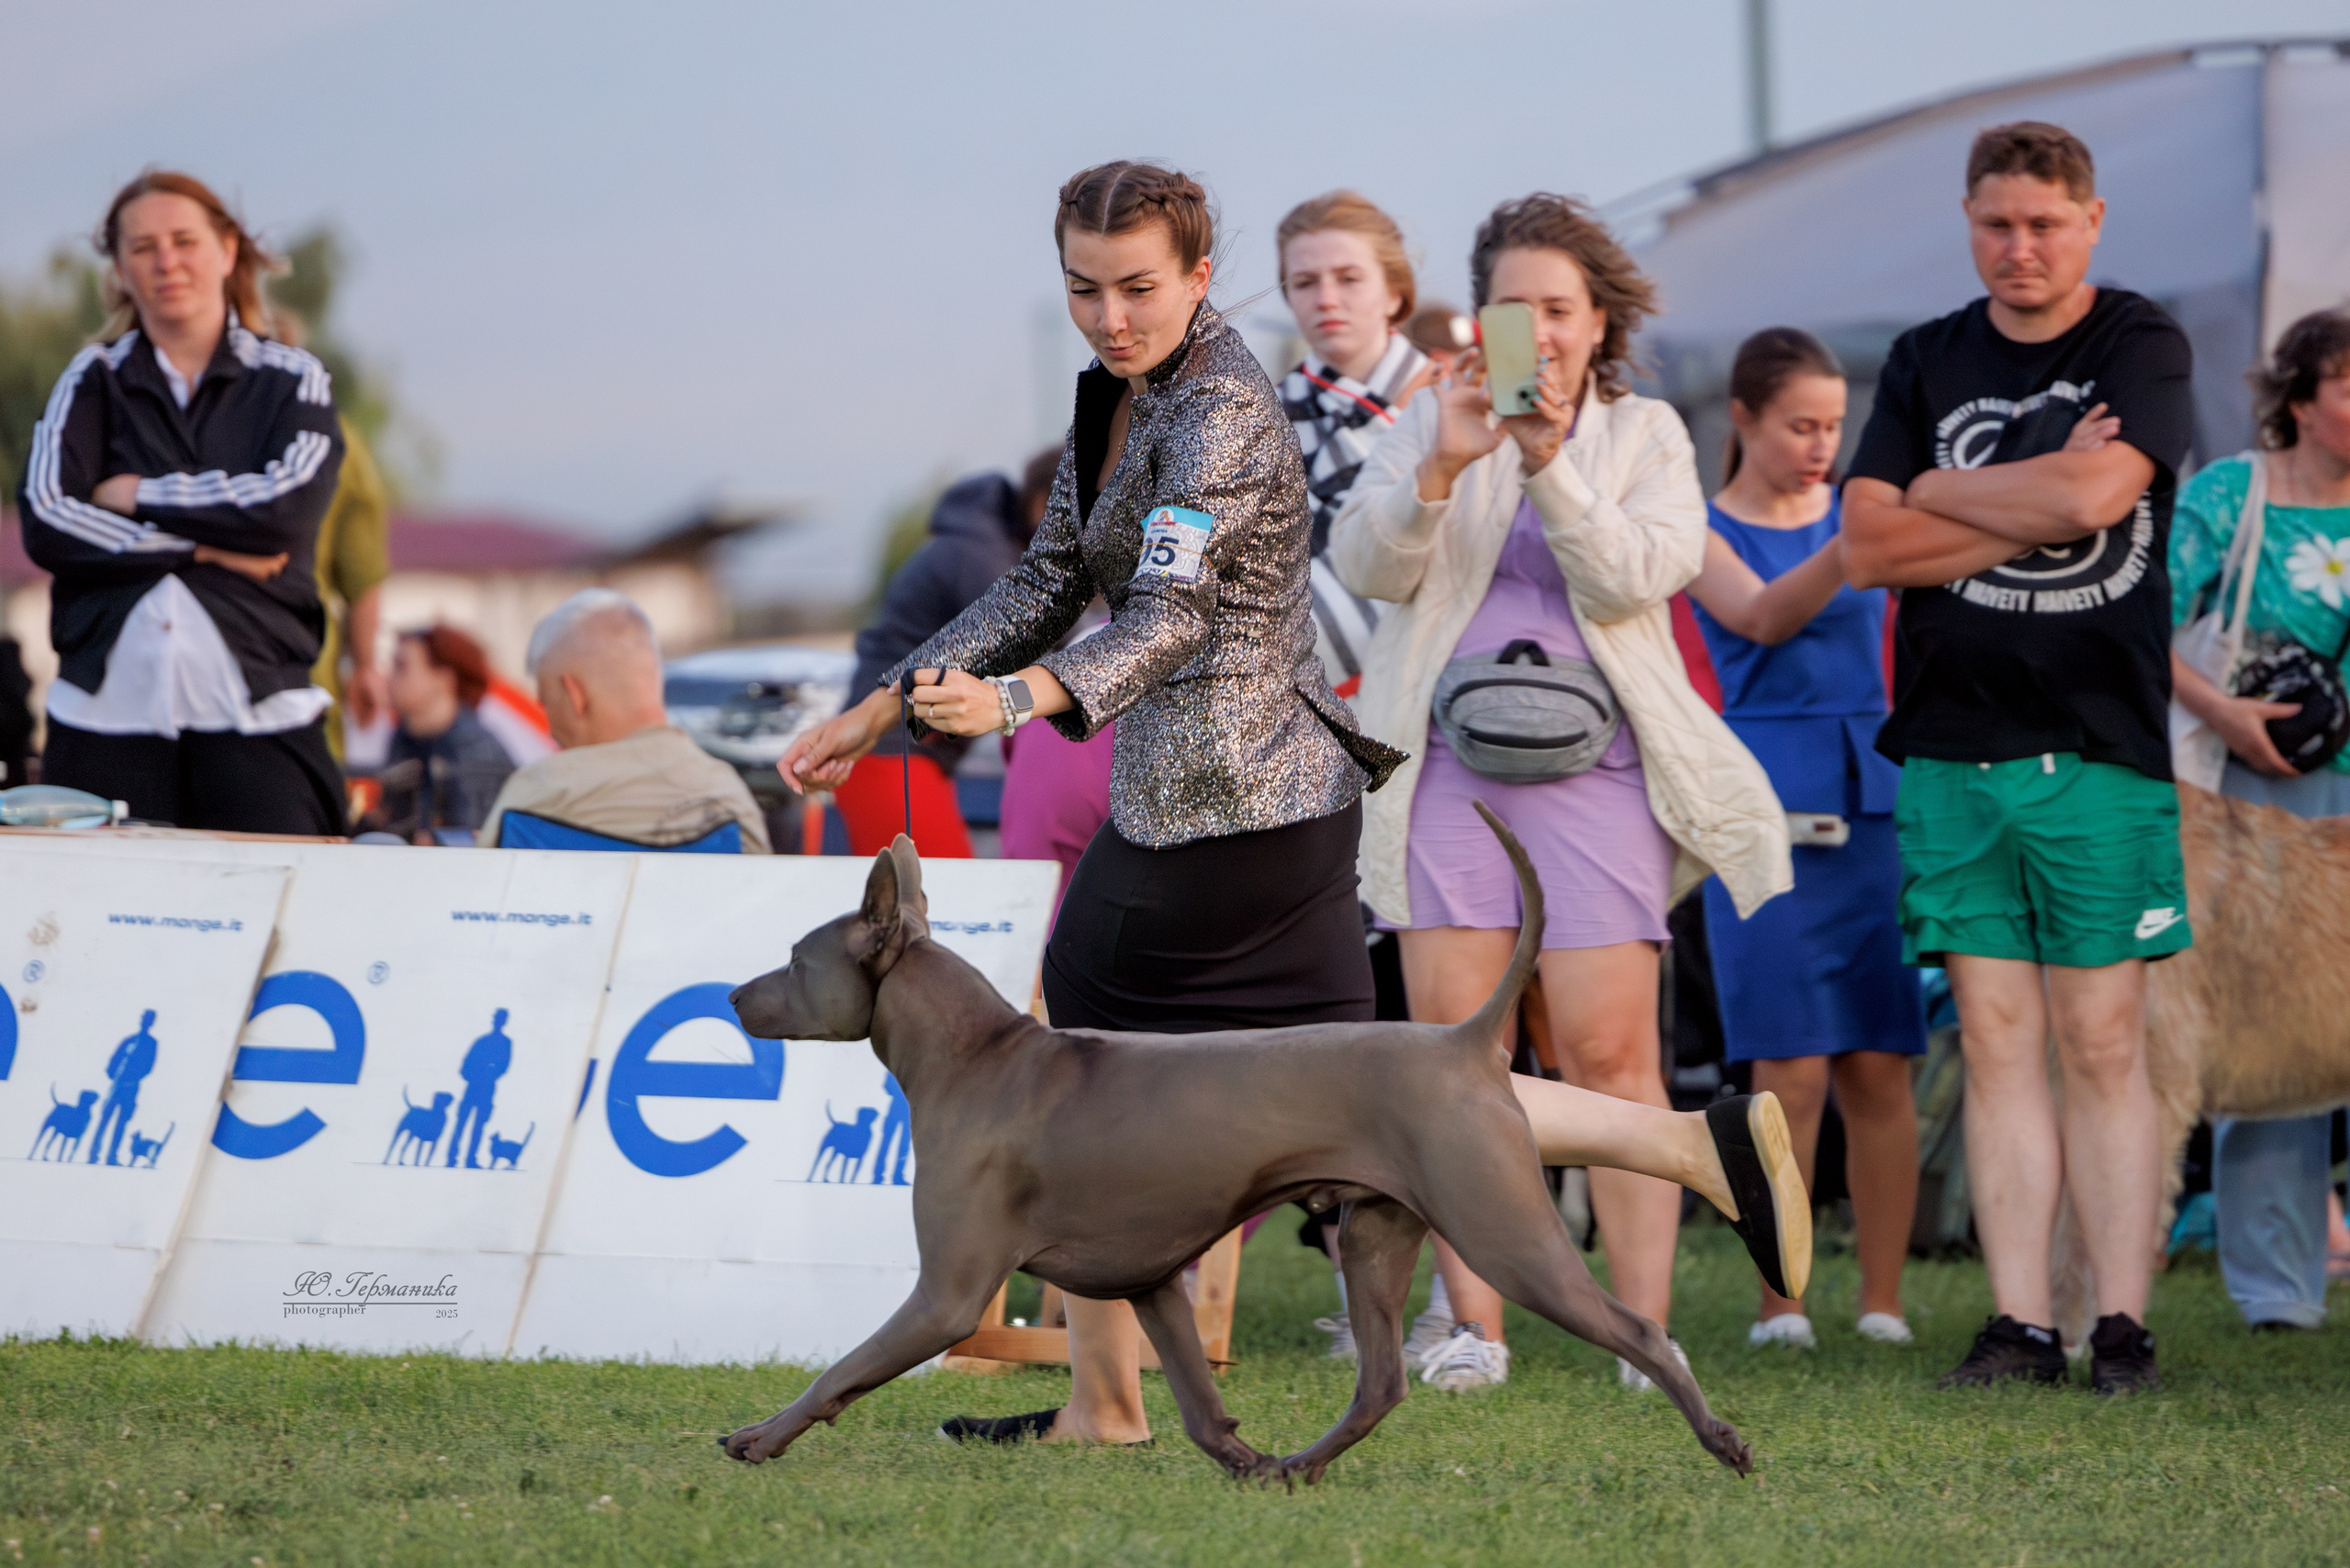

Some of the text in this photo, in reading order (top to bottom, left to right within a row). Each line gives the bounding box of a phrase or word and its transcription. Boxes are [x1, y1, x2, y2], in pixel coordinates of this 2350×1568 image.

[108, 913, 243, 932] www.monge.it
[451, 911, 593, 926] www.monge.it
[928, 920, 1013, 935] monge.it
